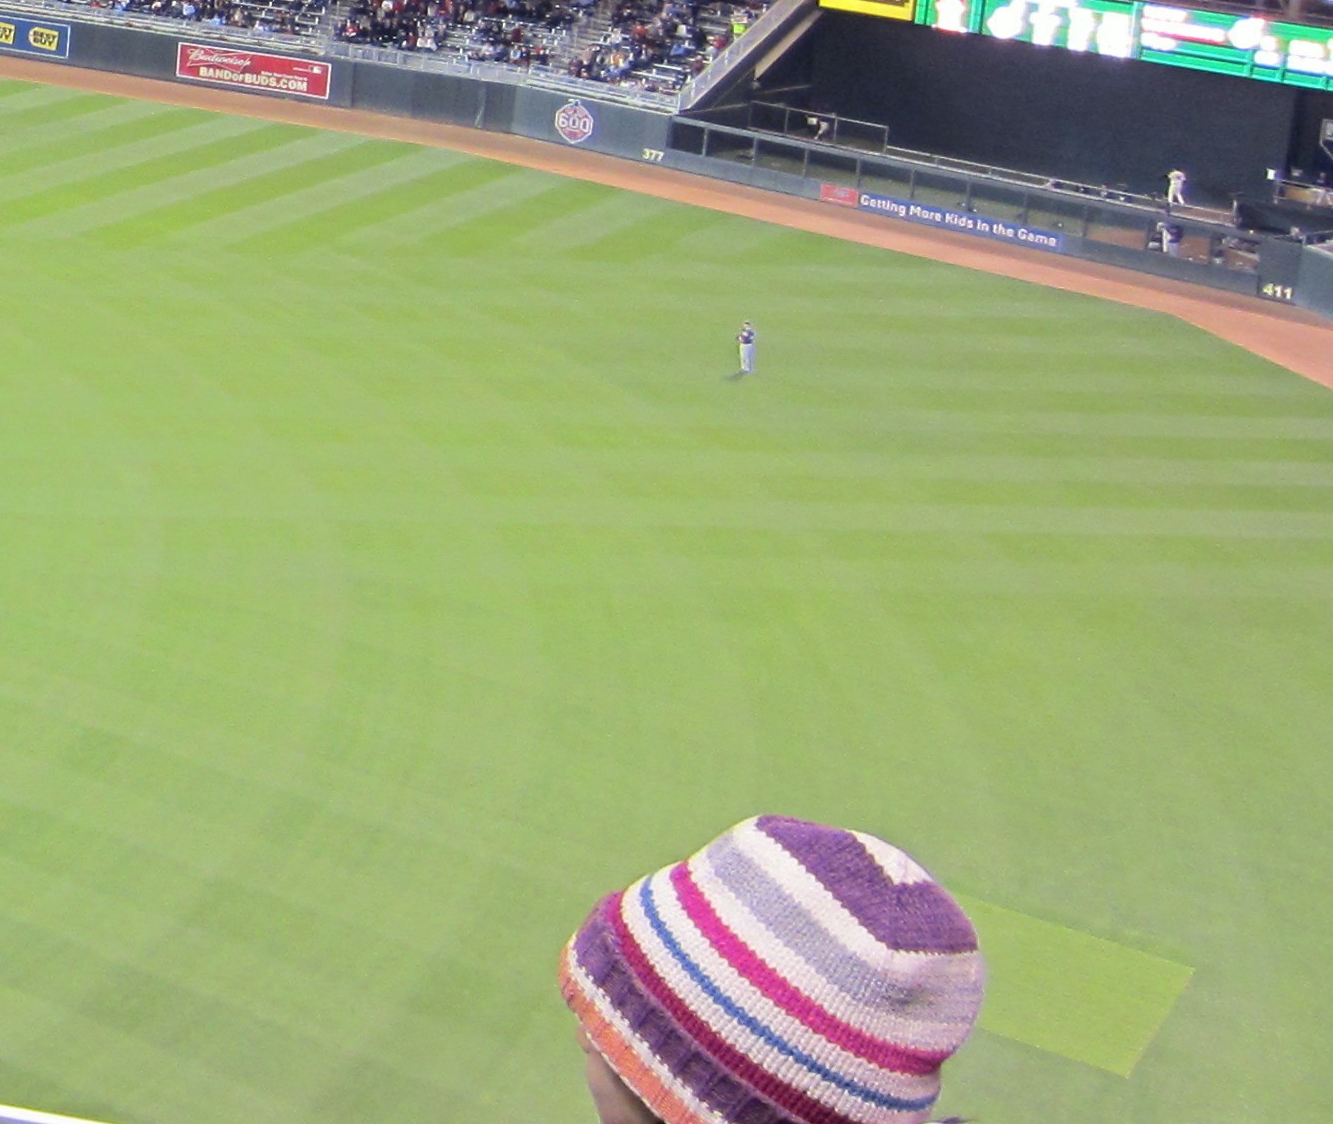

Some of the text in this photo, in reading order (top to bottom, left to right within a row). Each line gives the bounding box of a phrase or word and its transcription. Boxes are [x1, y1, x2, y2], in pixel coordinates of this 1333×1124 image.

[187, 48, 252, 67] Budweiser
[558, 113, 590, 133] 600
[641, 147, 664, 162] 377
[859, 193, 906, 217] Getting
[909, 204, 942, 223] More
[944, 211, 974, 229] Kids
[992, 222, 1014, 238] the
[1017, 227, 1057, 247] Game
[1262, 282, 1293, 301] 411
